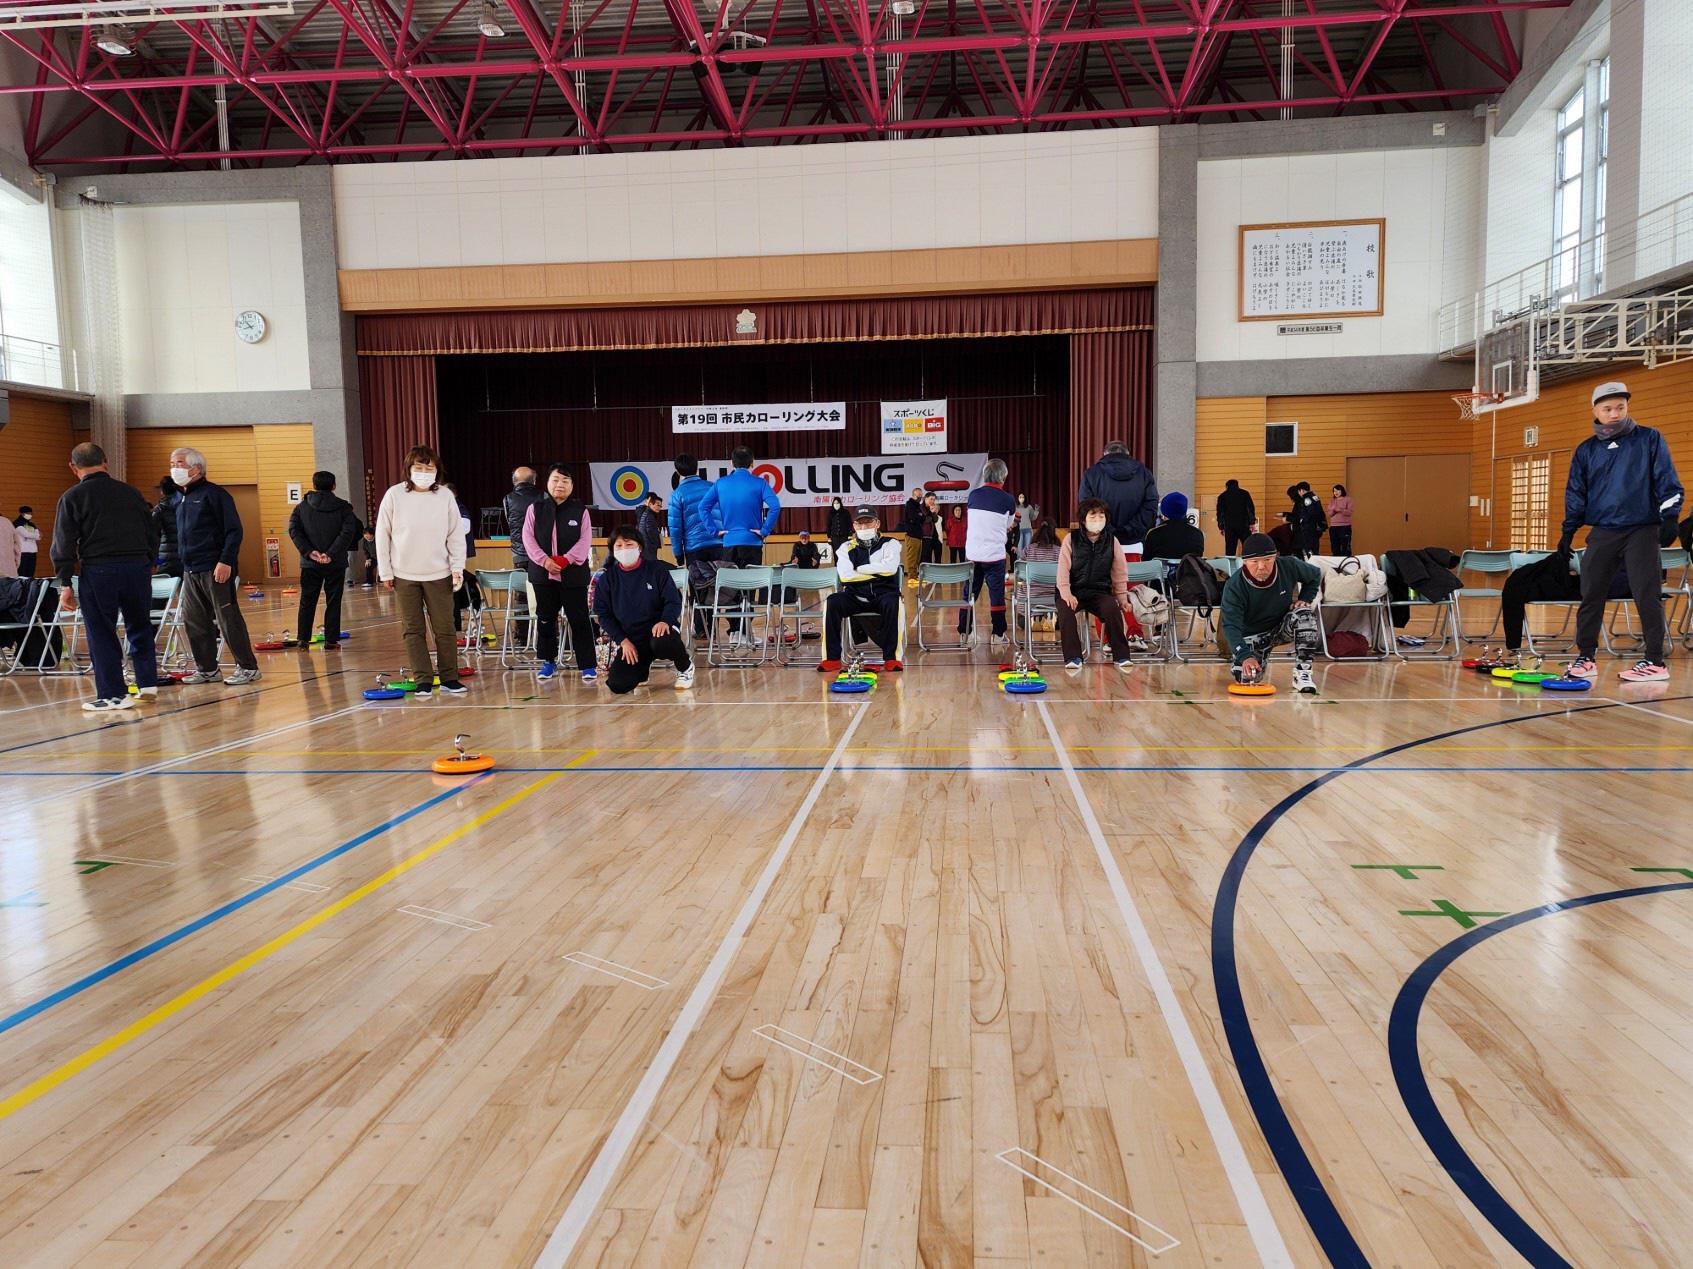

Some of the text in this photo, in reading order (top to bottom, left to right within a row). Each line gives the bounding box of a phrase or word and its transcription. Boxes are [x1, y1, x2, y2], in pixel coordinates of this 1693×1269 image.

[677, 409, 841, 426] 第19回 市民カローリング大会
[893, 408, 935, 418] スポーツくじ
[290, 489, 299, 501] E
[1187, 514, 1196, 525] 6
[820, 548, 829, 559] 4
